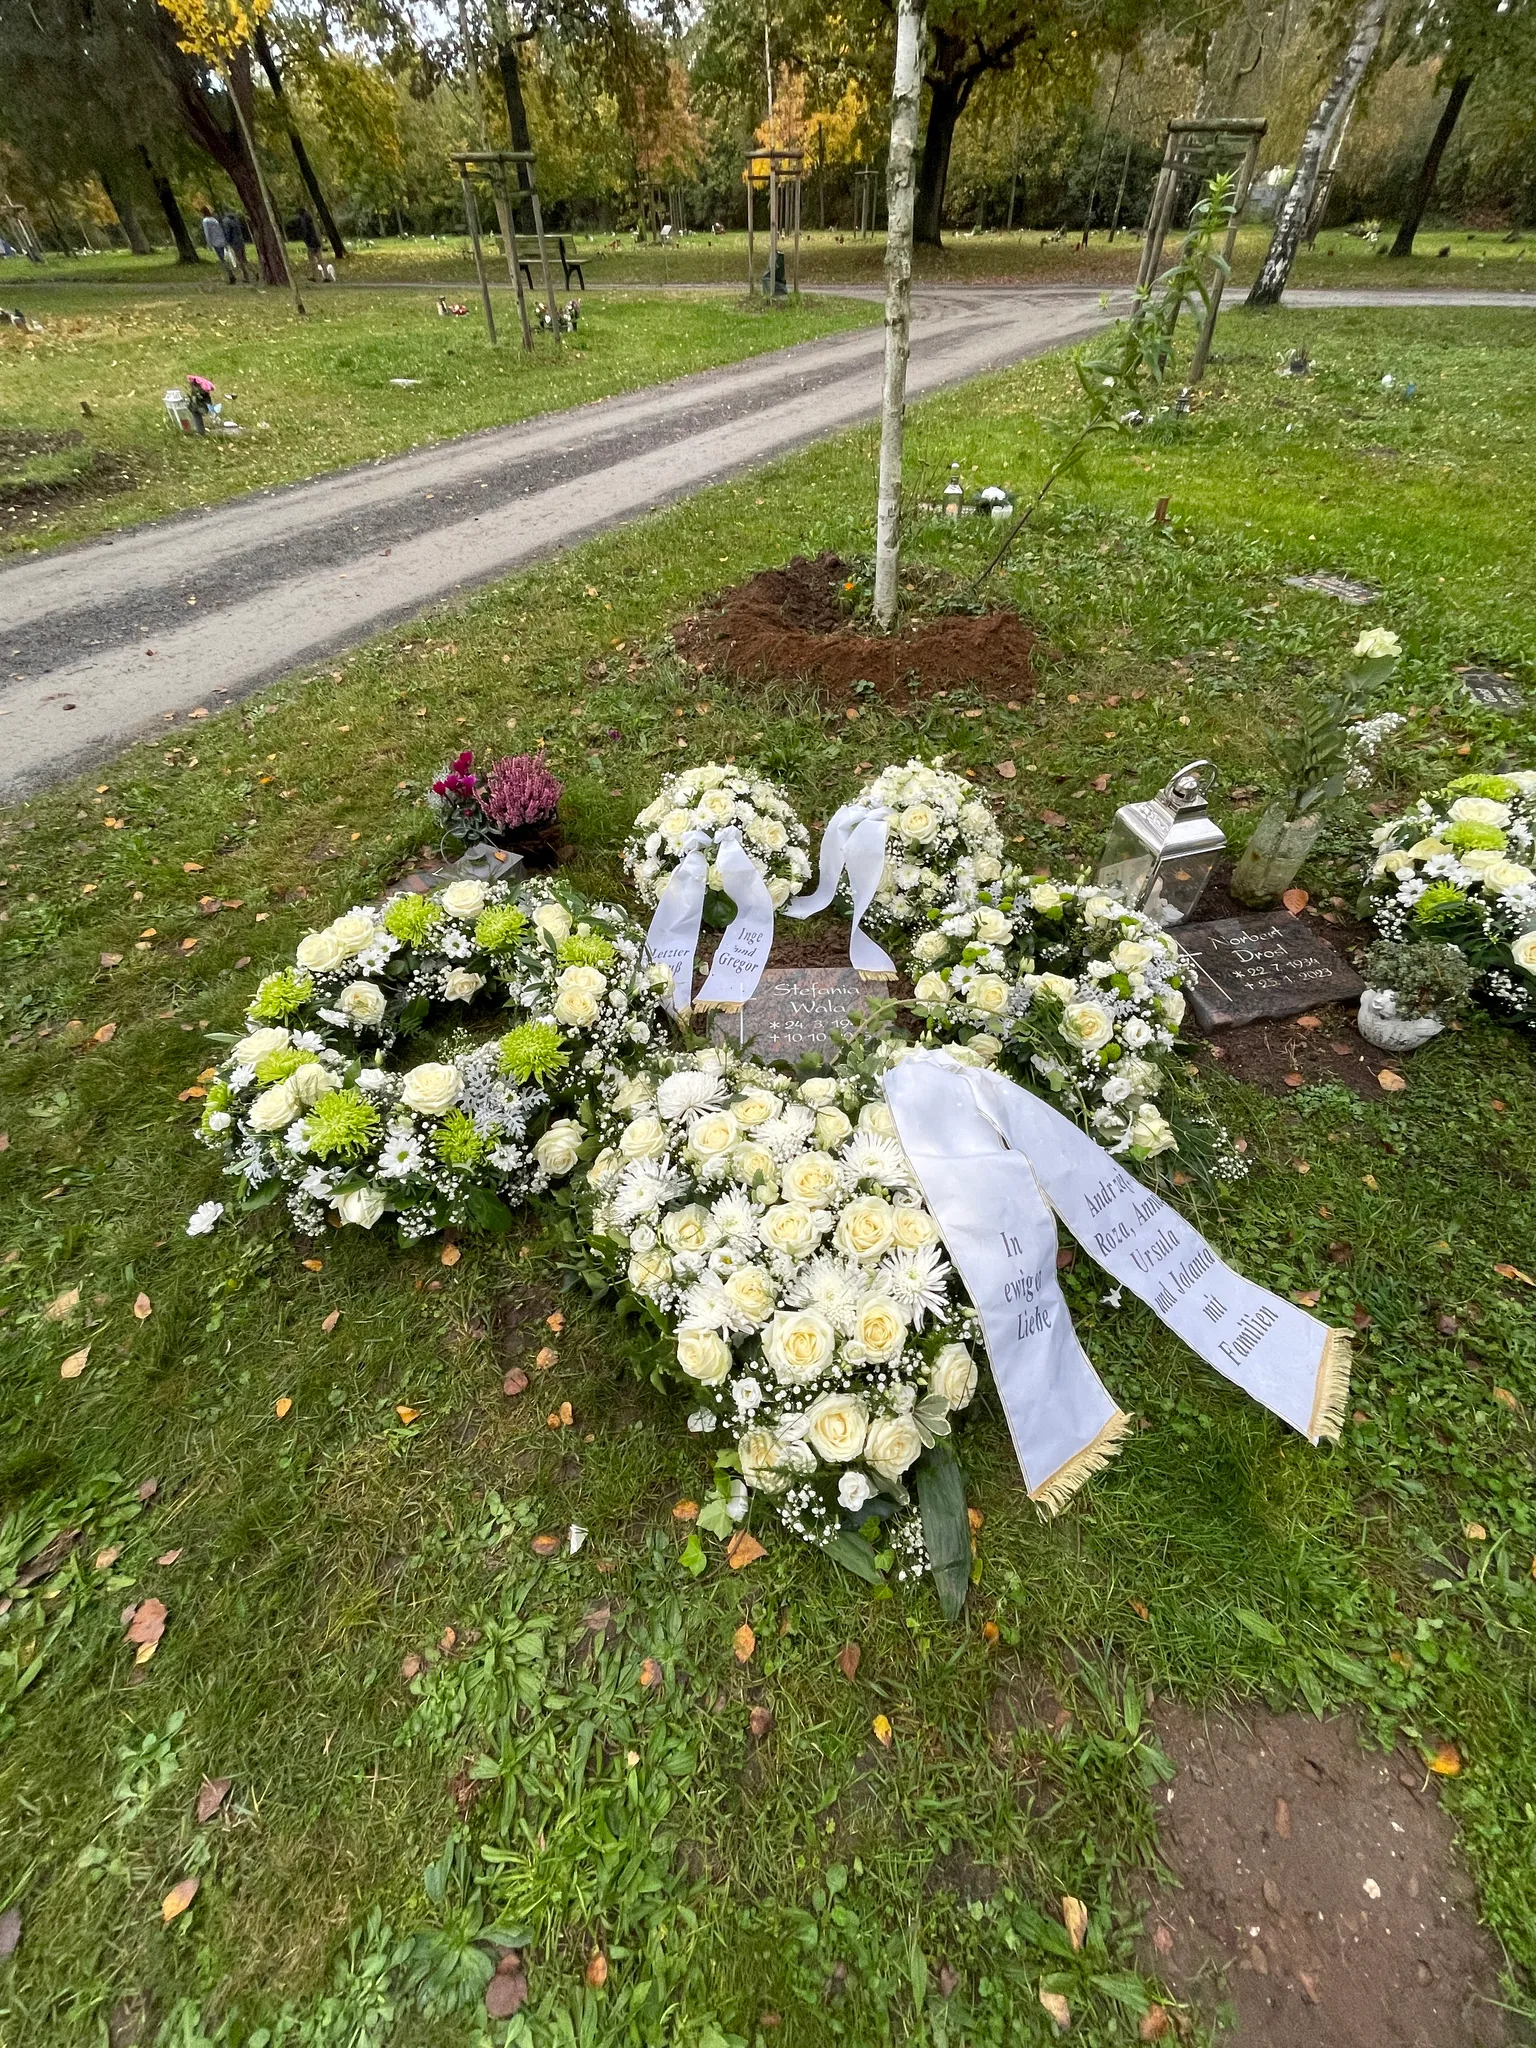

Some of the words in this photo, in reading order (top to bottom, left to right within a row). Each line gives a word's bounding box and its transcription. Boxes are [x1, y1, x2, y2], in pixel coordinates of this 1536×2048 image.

[737, 927, 764, 945] Inge
[1207, 925, 1284, 951] Norbert
[652, 948, 690, 959] Letzter
[718, 952, 759, 974] Gregor
[733, 945, 758, 957] und
[1298, 967, 1333, 982] 2023
[773, 982, 861, 997] Stefania
[789, 999, 846, 1014] Wala
[999, 1231, 1023, 1258] In
[1093, 1222, 1138, 1258] Roza,
[1129, 1227, 1181, 1274] Ursula
[1004, 1269, 1043, 1303] ewiger
[1153, 1281, 1179, 1315] und
[1168, 1246, 1217, 1295] Jolanta
[1202, 1293, 1229, 1324] mit
[1017, 1305, 1052, 1341] Liebe
[1217, 1305, 1280, 1367] Familien
